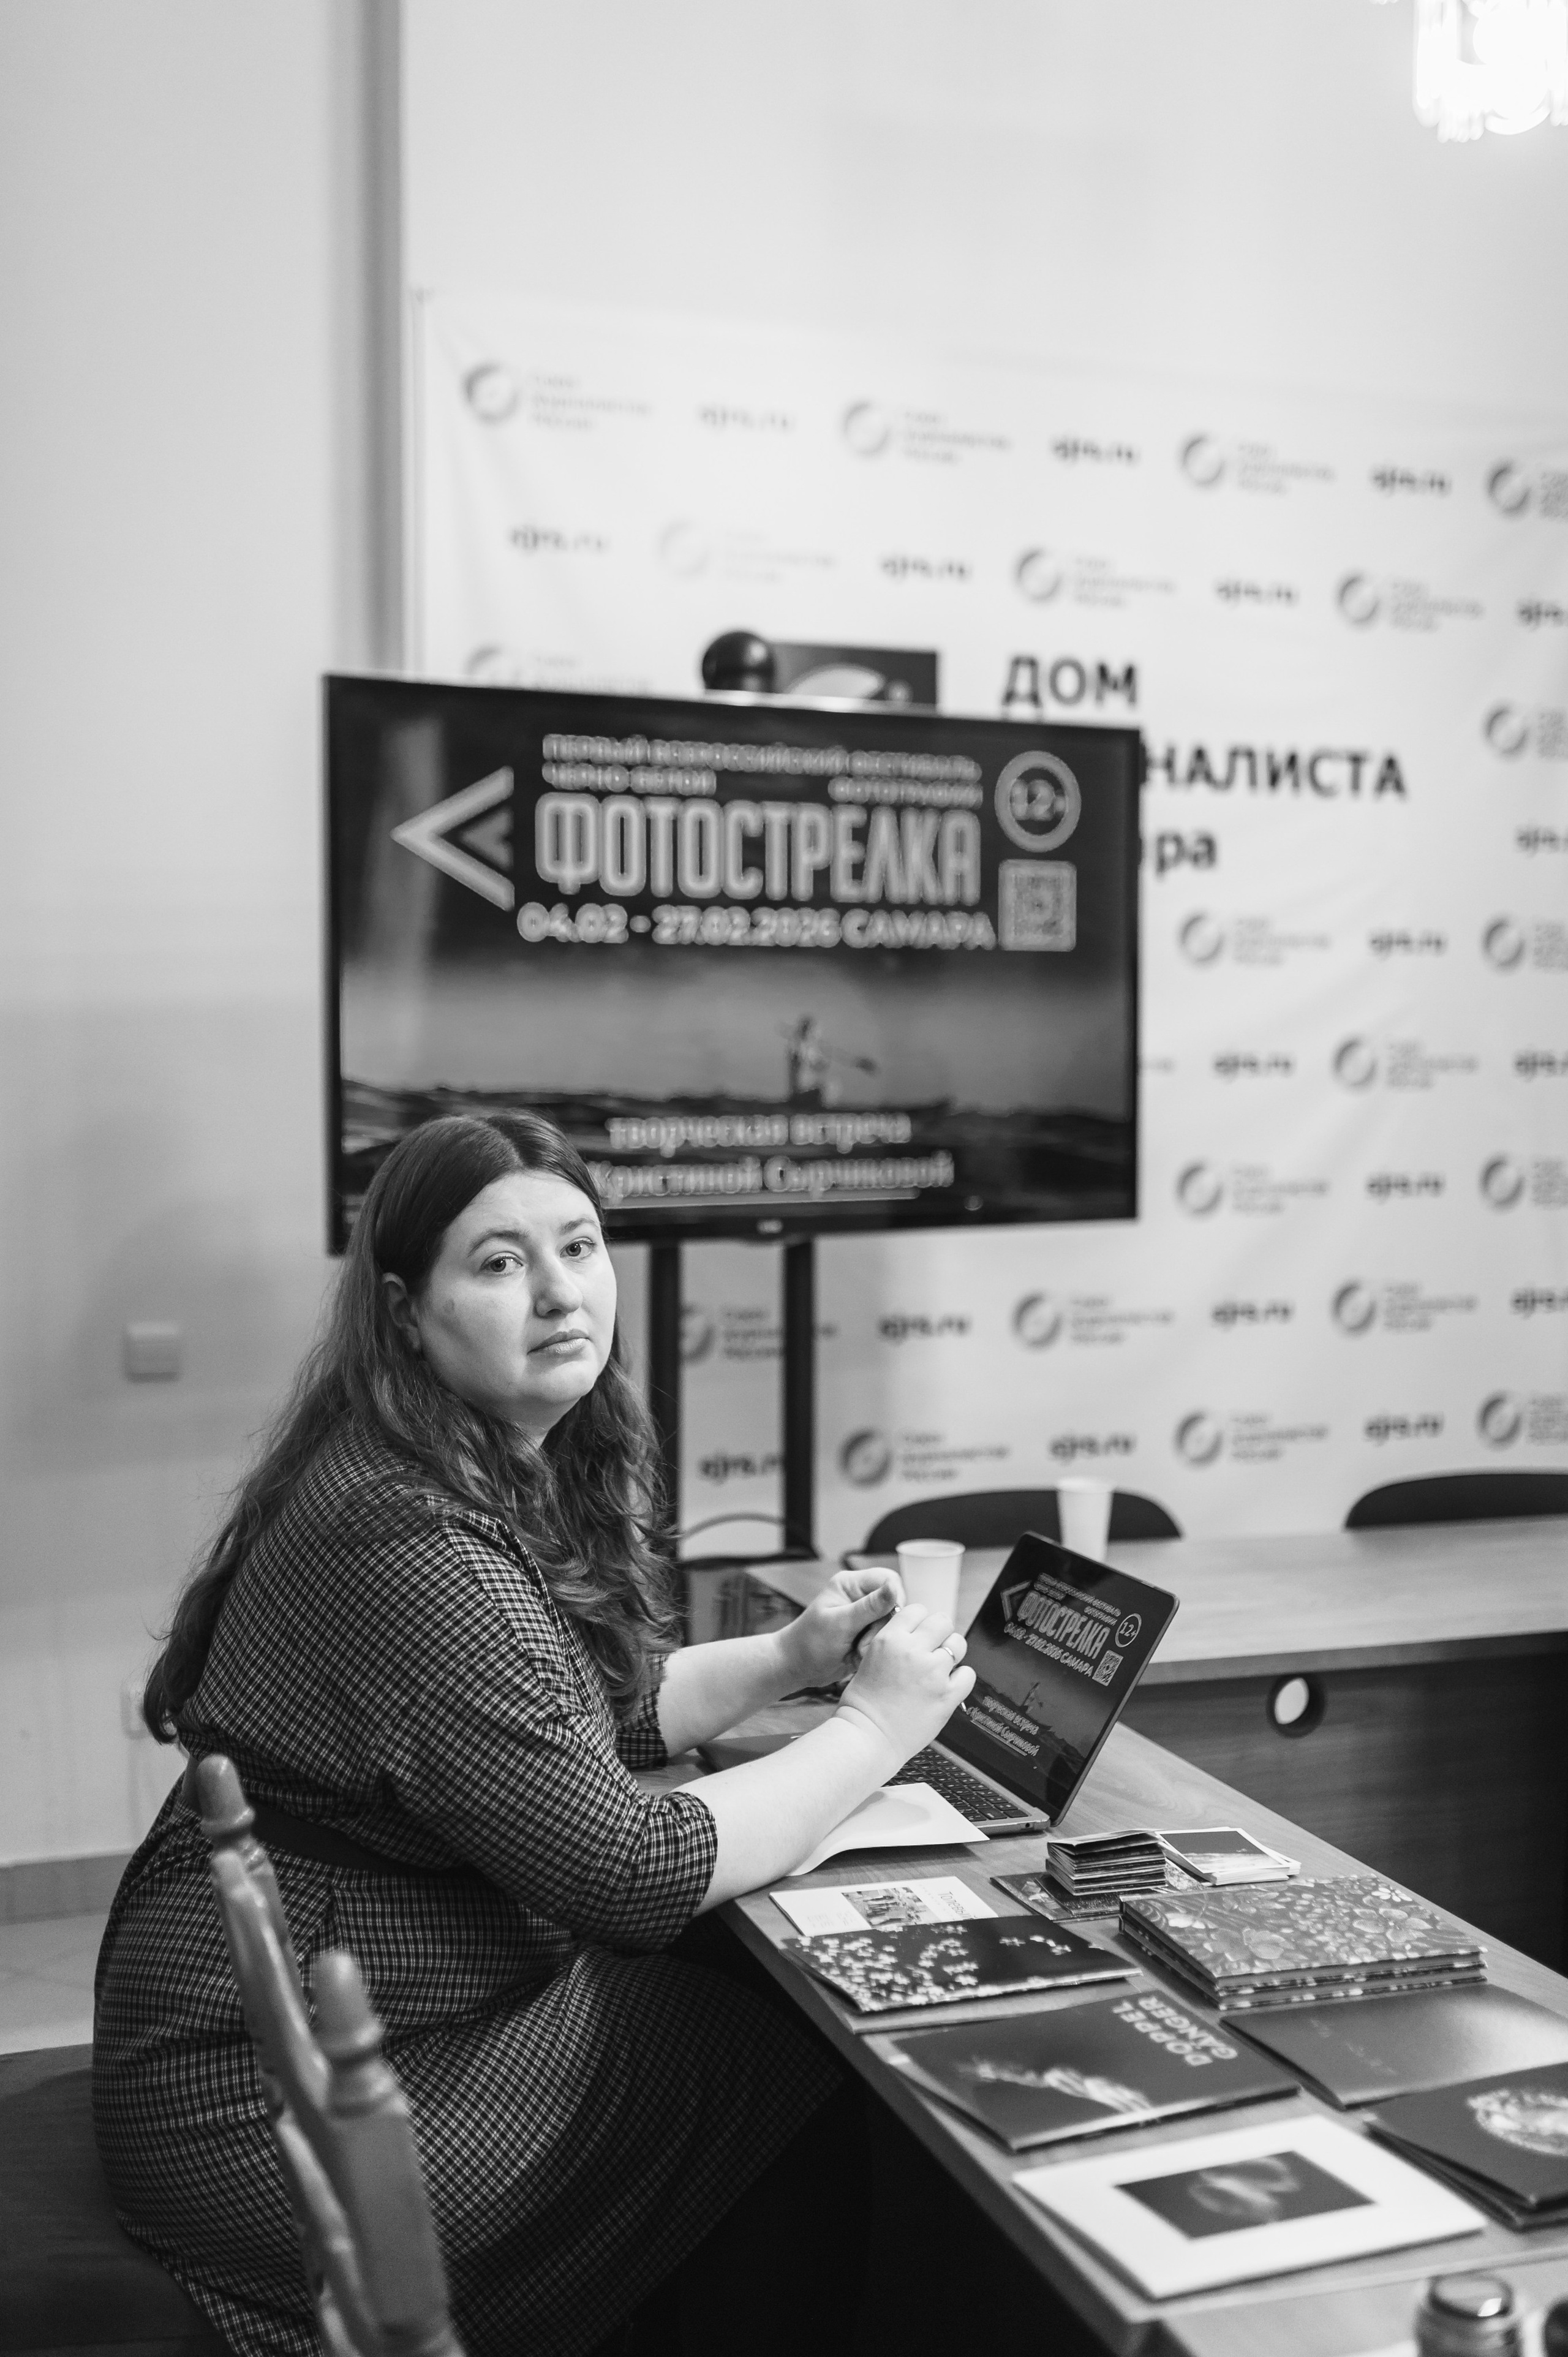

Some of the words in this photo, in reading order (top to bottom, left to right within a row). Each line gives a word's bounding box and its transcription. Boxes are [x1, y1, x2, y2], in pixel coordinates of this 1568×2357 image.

[1001, 653, 1138, 718] ДОМ
[1140, 744, 1409, 798] НАЛИСТА
[535, 792, 981, 905] ФОТОСТРЕЛКА
[1155, 832, 1218, 880] ра
[840, 908, 997, 951] САМАРА
[1017, 1590, 1111, 1660] ФОТОСТРЕЛКА
[1119, 1621, 1137, 1638] 12+
[1060, 1651, 1094, 1677] САМАРА
[1112, 1999, 1213, 2067] DOPPEL
[1138, 1996, 1238, 2059] GÄNGER
